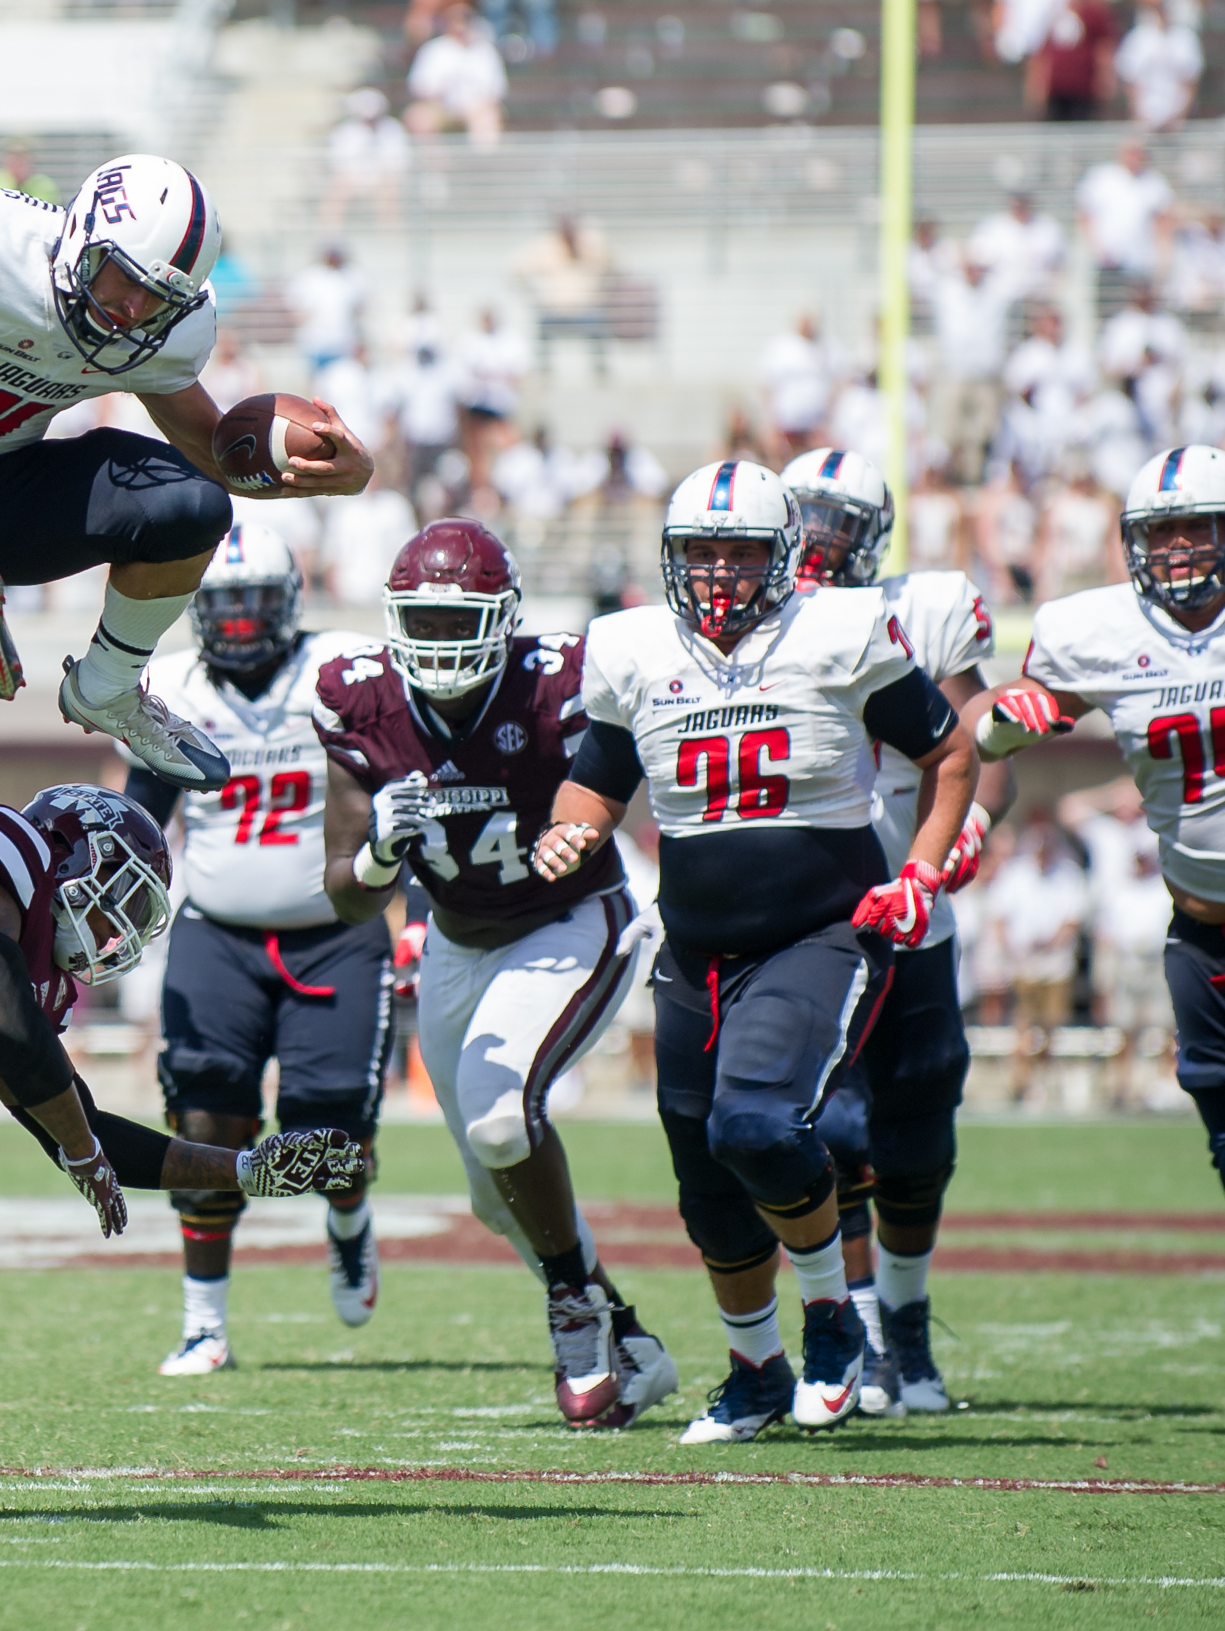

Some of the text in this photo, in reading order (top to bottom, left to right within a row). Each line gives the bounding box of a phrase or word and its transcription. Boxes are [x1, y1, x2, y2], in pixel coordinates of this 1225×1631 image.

[97, 165, 137, 224] JAGS
[652, 696, 702, 706] SUN BELT
[1153, 680, 1225, 709] JAGUA
[678, 705, 779, 733] JAGUARS
[496, 727, 524, 751] SEC
[677, 726, 790, 822] 76
[66, 790, 113, 818] STATE
[221, 771, 311, 846] 72
[429, 789, 509, 804] SISSIPPI
